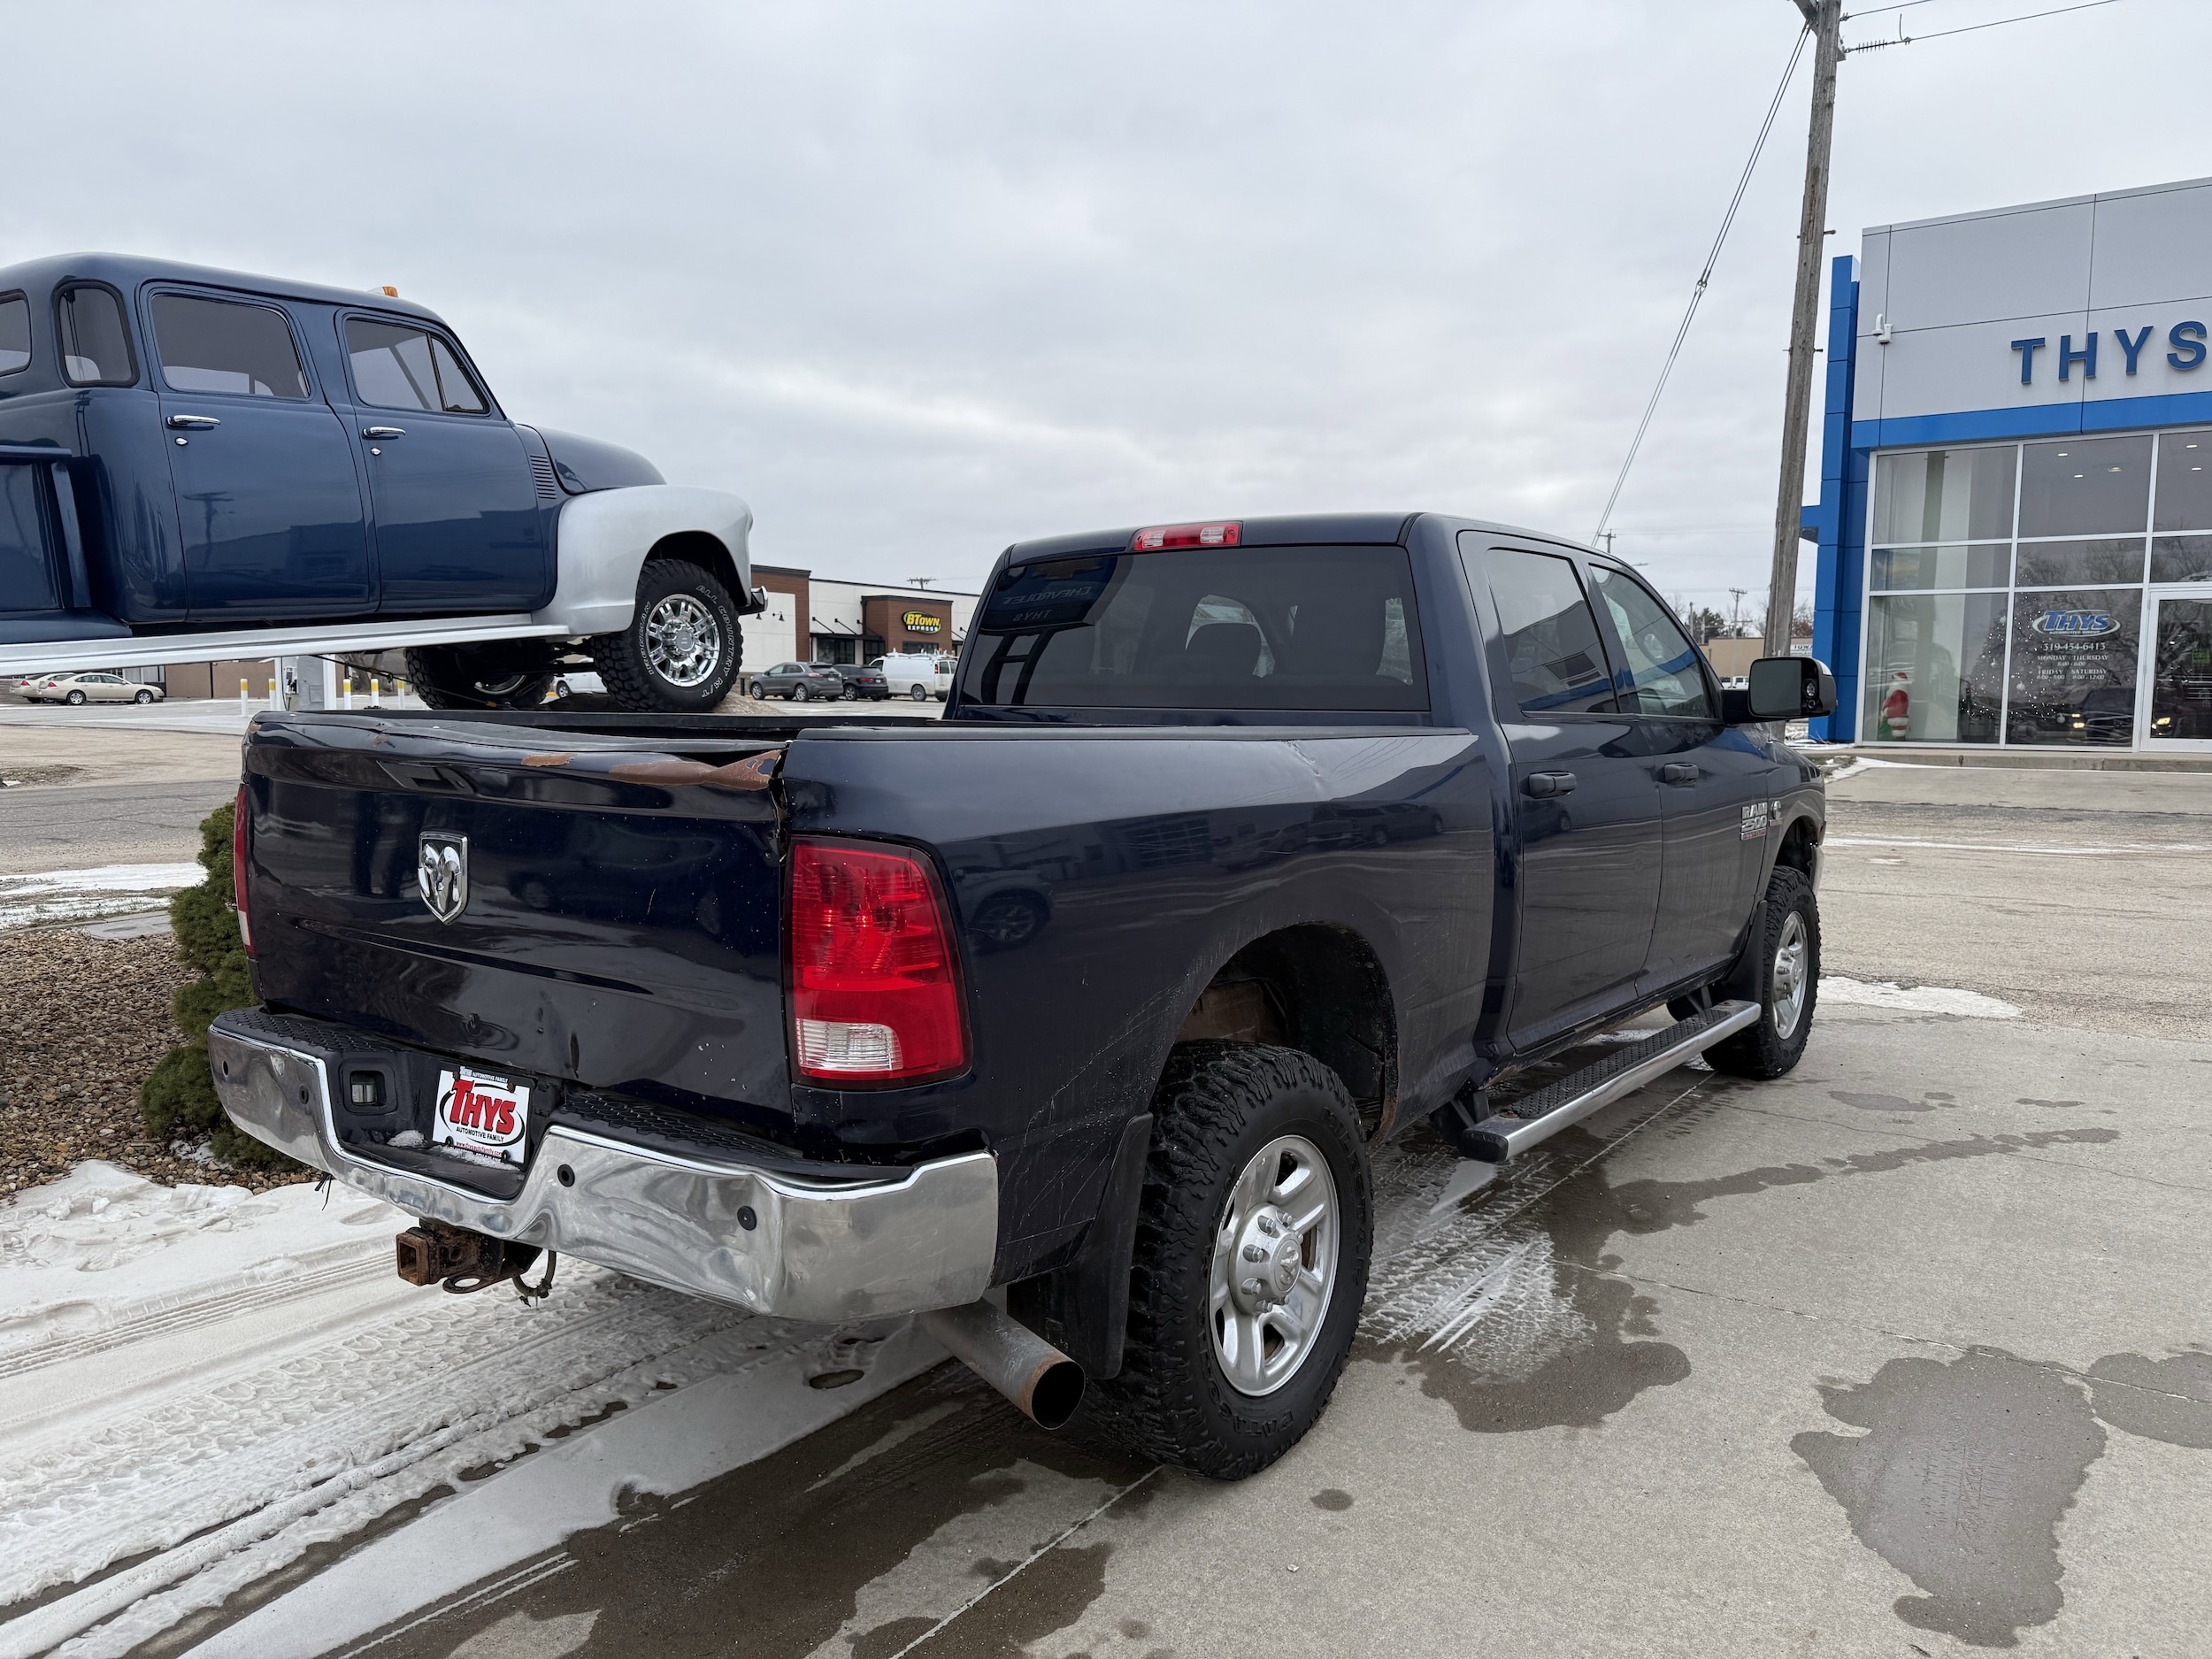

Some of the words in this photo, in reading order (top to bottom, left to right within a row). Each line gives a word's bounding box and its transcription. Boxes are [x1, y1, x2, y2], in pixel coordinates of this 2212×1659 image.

[2010, 320, 2208, 385] THYS
[695, 585, 718, 604] ALL
[2042, 610, 2110, 631] THYS
[718, 605, 735, 677] COUNTRY
[702, 677, 724, 698] M/T
[1741, 802, 1768, 819] RAM
[449, 1079, 517, 1135] THYS
[456, 1125, 487, 1139] AUTOMOTIVE
[487, 1133, 504, 1142] FAMILY
